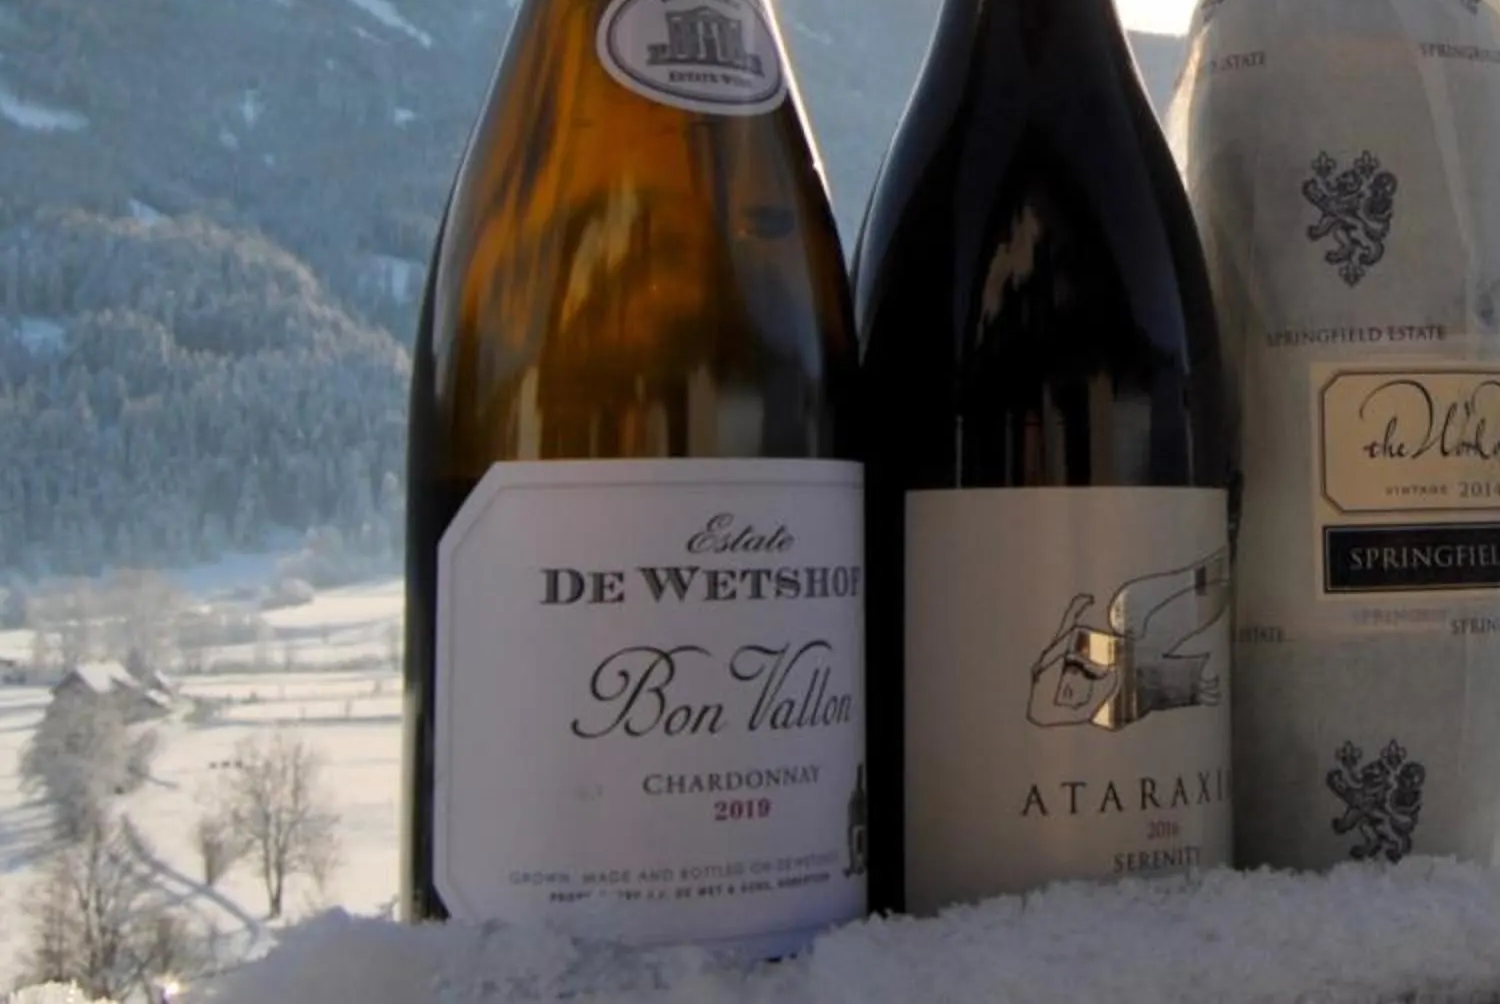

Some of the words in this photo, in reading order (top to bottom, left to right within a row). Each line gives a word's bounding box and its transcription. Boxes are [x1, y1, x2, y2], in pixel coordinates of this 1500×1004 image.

[1388, 324, 1447, 341] ESTATE
[1385, 483, 1448, 496] VINTAGE
[687, 512, 796, 555] Estate
[540, 568, 625, 604] DE
[571, 645, 726, 739] Bon
[729, 639, 852, 732] Vallon
[642, 765, 821, 795] CHARDONNAY
[1021, 767, 1231, 816] ATARAXI
[714, 798, 772, 821] 2019
